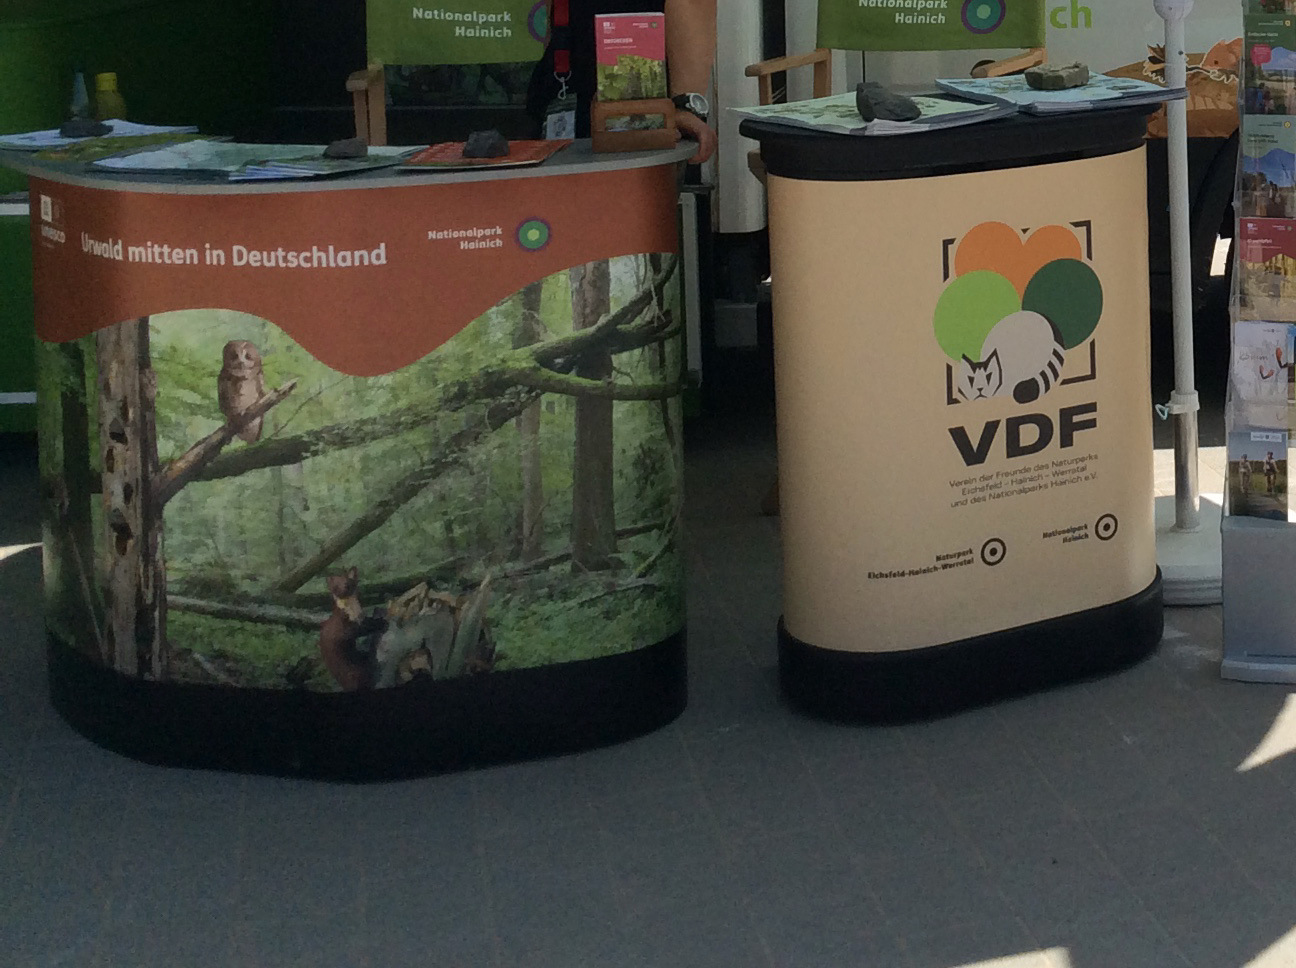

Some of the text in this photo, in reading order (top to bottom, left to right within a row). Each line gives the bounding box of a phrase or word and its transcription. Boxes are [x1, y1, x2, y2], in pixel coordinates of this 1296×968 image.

[412, 7, 512, 25] Nationalpark
[895, 12, 946, 24] Hainich
[455, 25, 512, 38] Hainich
[427, 225, 503, 240] Nationalpark
[81, 231, 387, 268] Urwald mitten in Deutschland
[460, 237, 503, 249] Hainich
[947, 401, 1099, 467] VDF
[949, 453, 1098, 488] Verein der Freunde des Naturparks
[961, 480, 1003, 496] Eichsfeld
[1010, 472, 1044, 486] Hainich
[1051, 464, 1088, 478] Werratal
[950, 498, 968, 508] und
[970, 494, 986, 504] des
[988, 483, 1049, 500] Nationalparks
[1050, 474, 1083, 488] Hainich
[1042, 523, 1089, 539] Nationalpark
[935, 548, 974, 562] Naturpark
